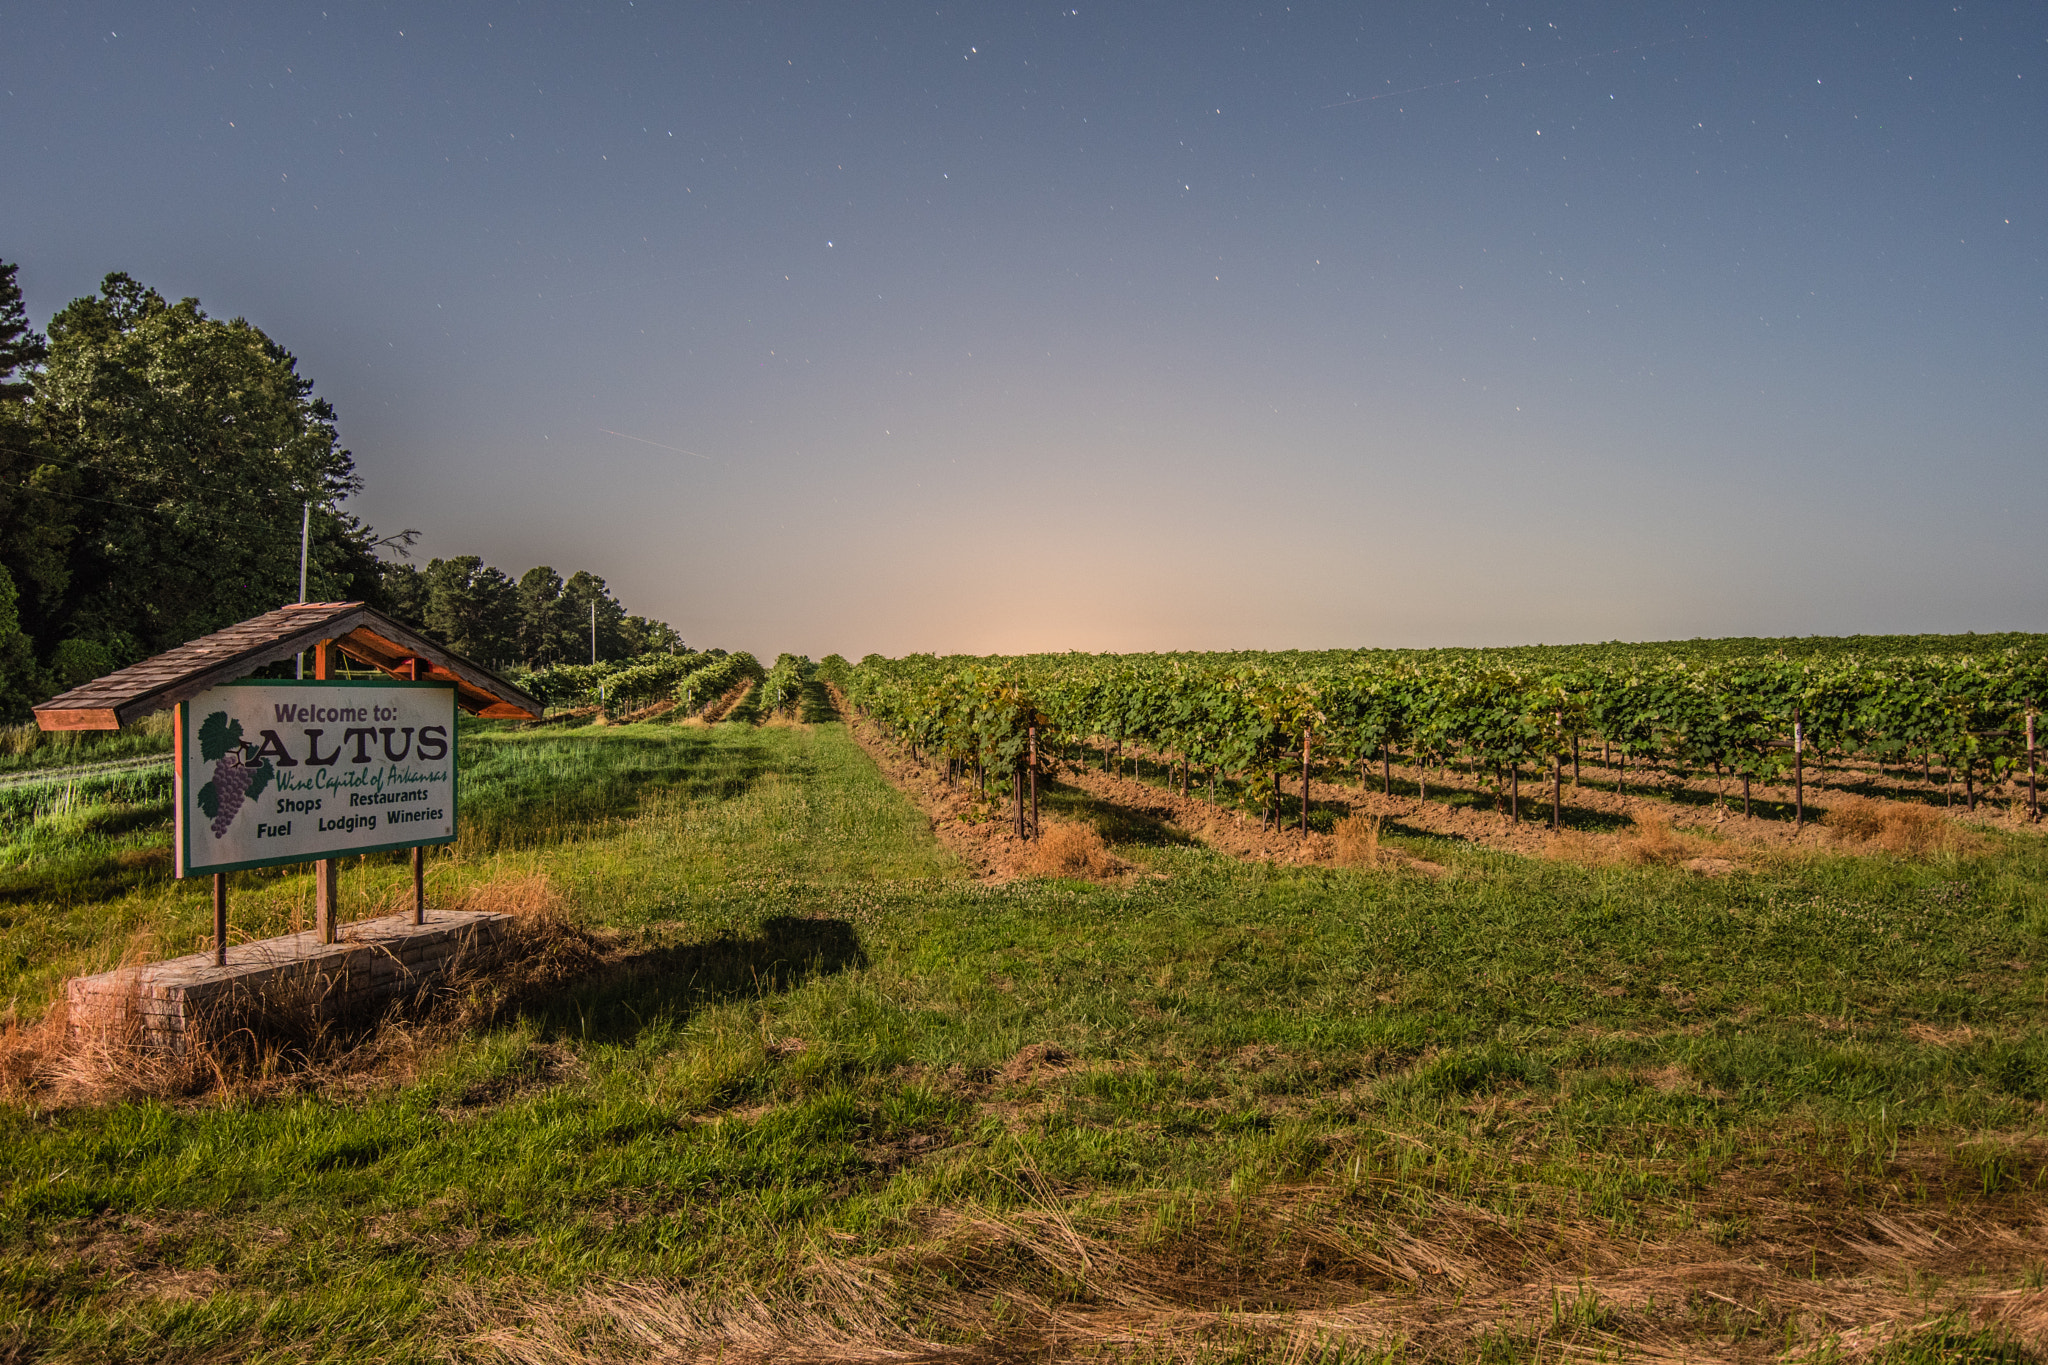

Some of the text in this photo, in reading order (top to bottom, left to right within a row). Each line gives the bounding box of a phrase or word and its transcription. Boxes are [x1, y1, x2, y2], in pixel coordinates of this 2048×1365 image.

[274, 703, 397, 723] Welcome to:
[244, 725, 448, 767] ALTUS
[276, 764, 448, 798] Wine Capitol of Arkansas
[276, 789, 428, 815] Shops Restaurants
[257, 807, 443, 838] Fuel Lodging Wineries
